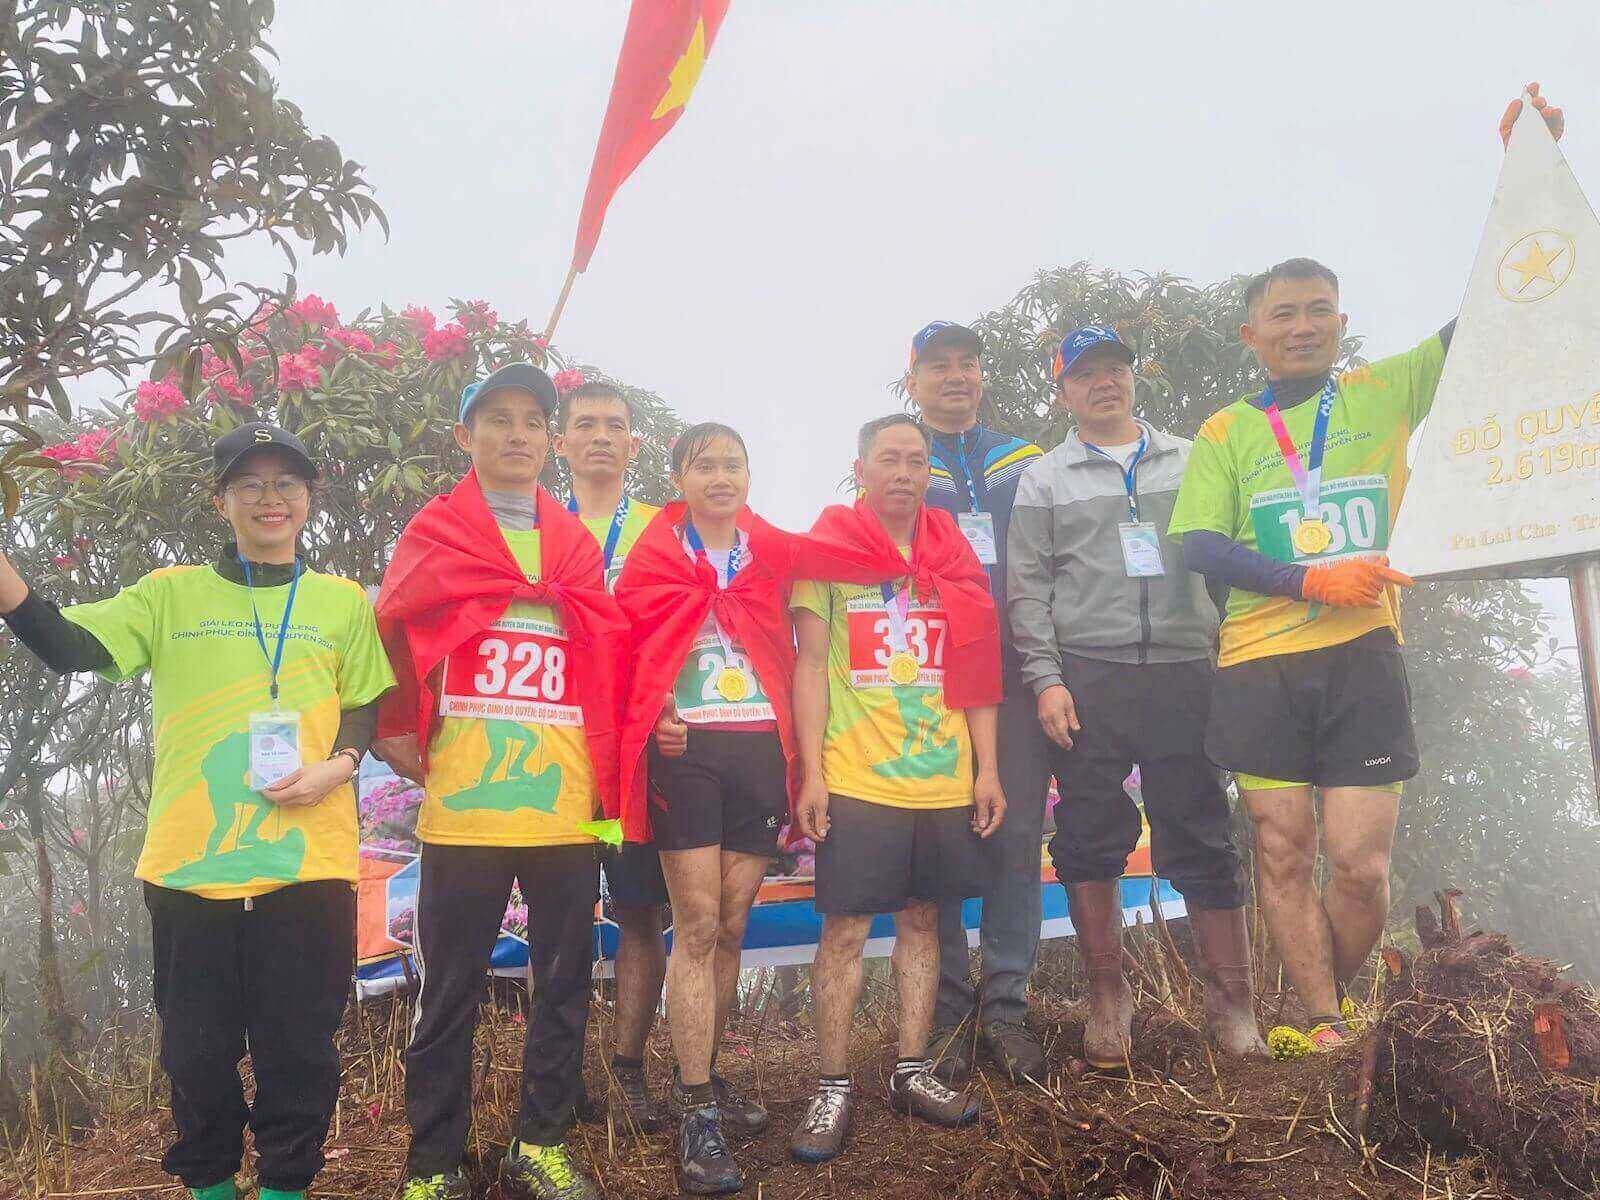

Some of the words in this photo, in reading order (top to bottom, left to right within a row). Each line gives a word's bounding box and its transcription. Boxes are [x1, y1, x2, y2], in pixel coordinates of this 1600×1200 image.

[254, 428, 273, 443] S
[1454, 413, 1502, 456] ĐỖ
[873, 618, 949, 666] 337
[474, 638, 566, 702] 328
